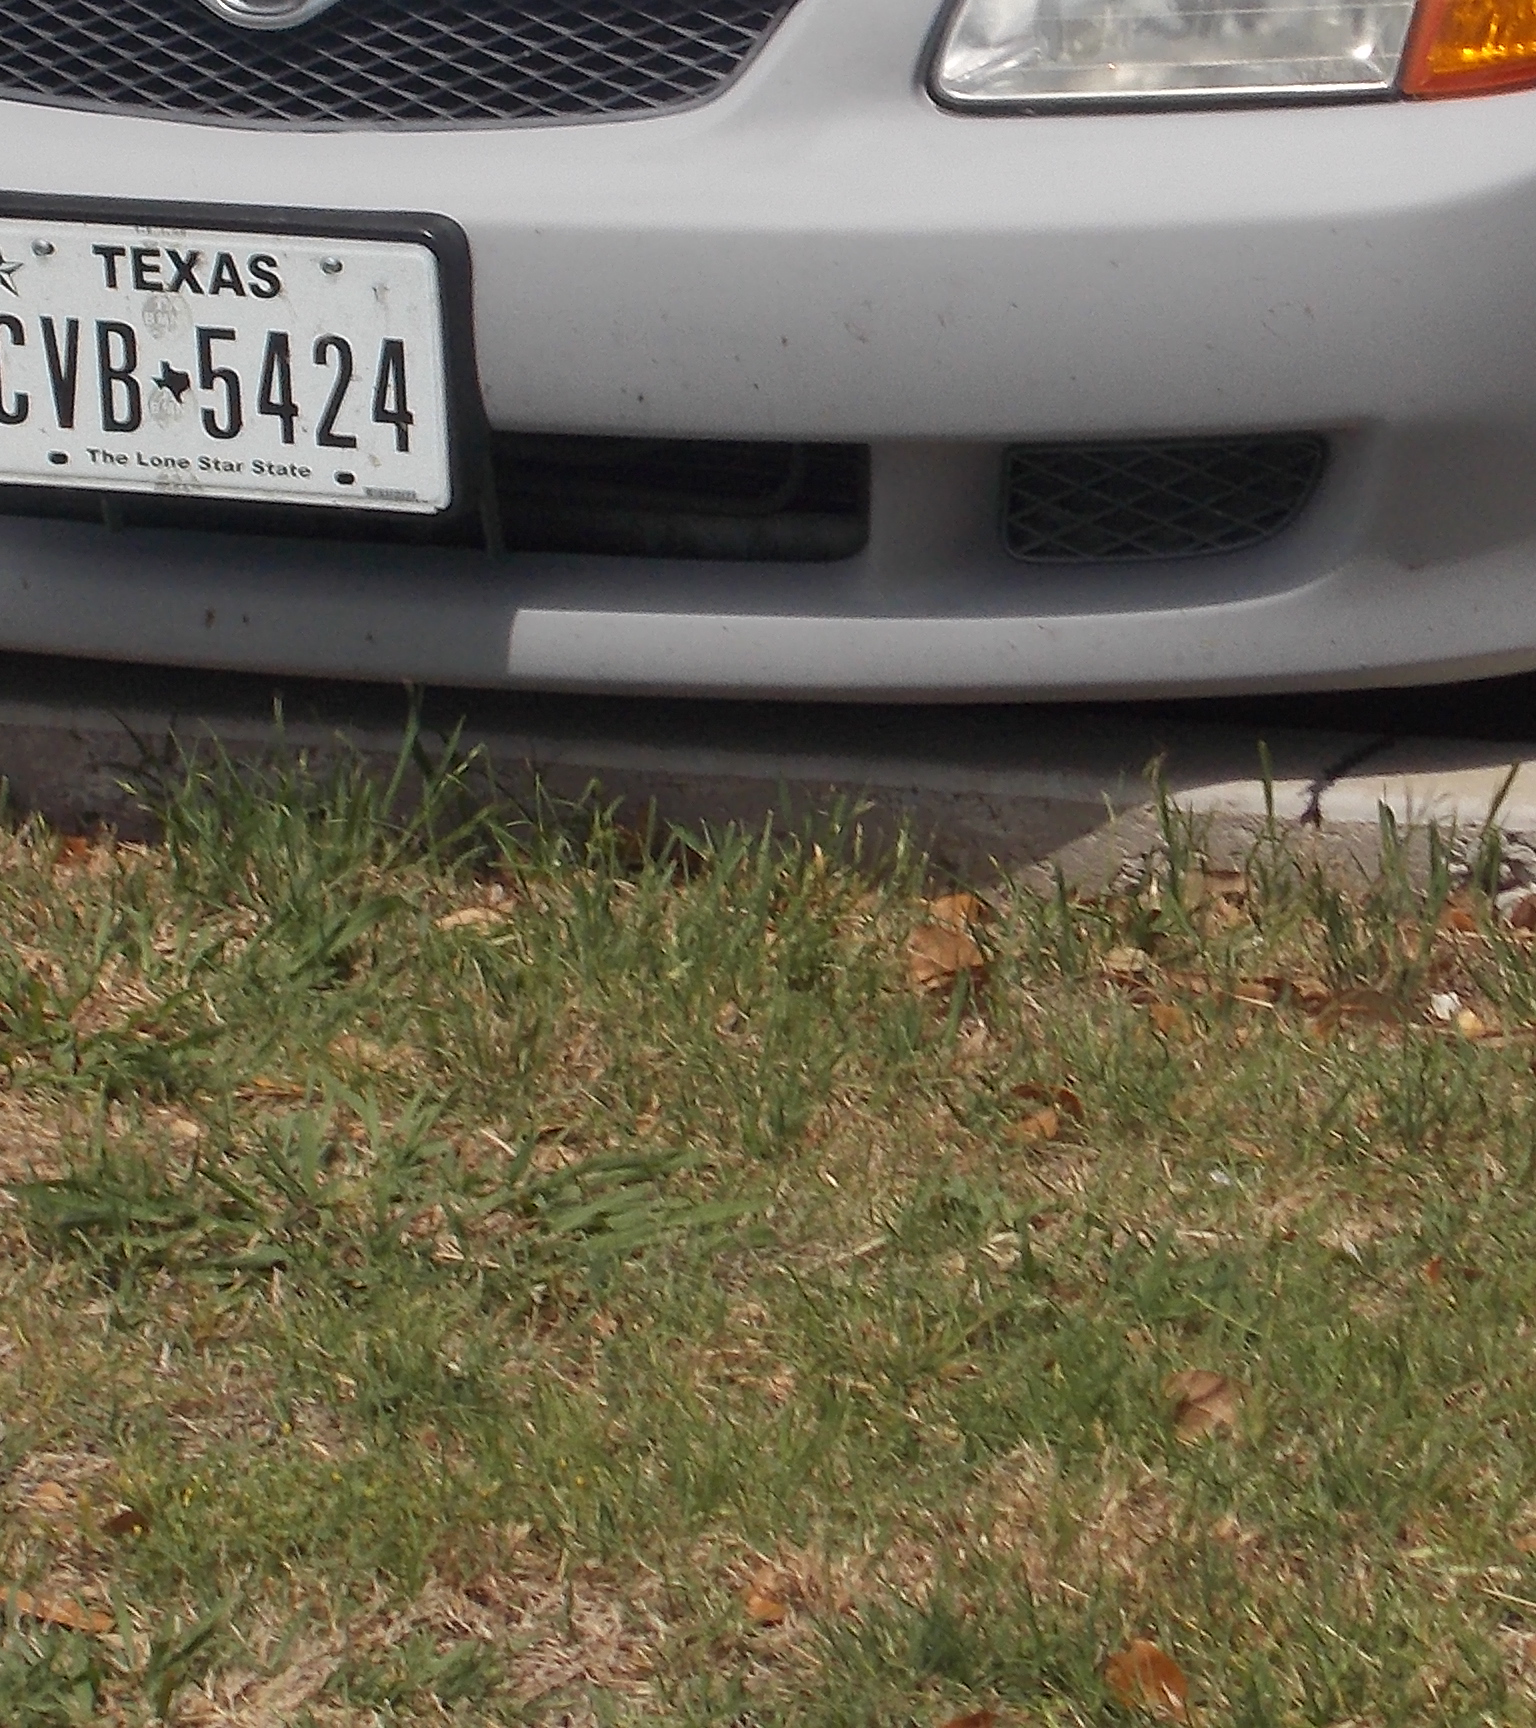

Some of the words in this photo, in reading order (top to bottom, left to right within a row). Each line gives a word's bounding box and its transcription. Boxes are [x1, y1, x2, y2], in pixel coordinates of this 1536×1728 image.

[91, 243, 282, 299] TEXAS
[195, 325, 415, 453] 5424
[86, 447, 128, 466] The
[137, 451, 191, 470] Lone
[197, 454, 243, 473] Star
[251, 458, 312, 478] State
